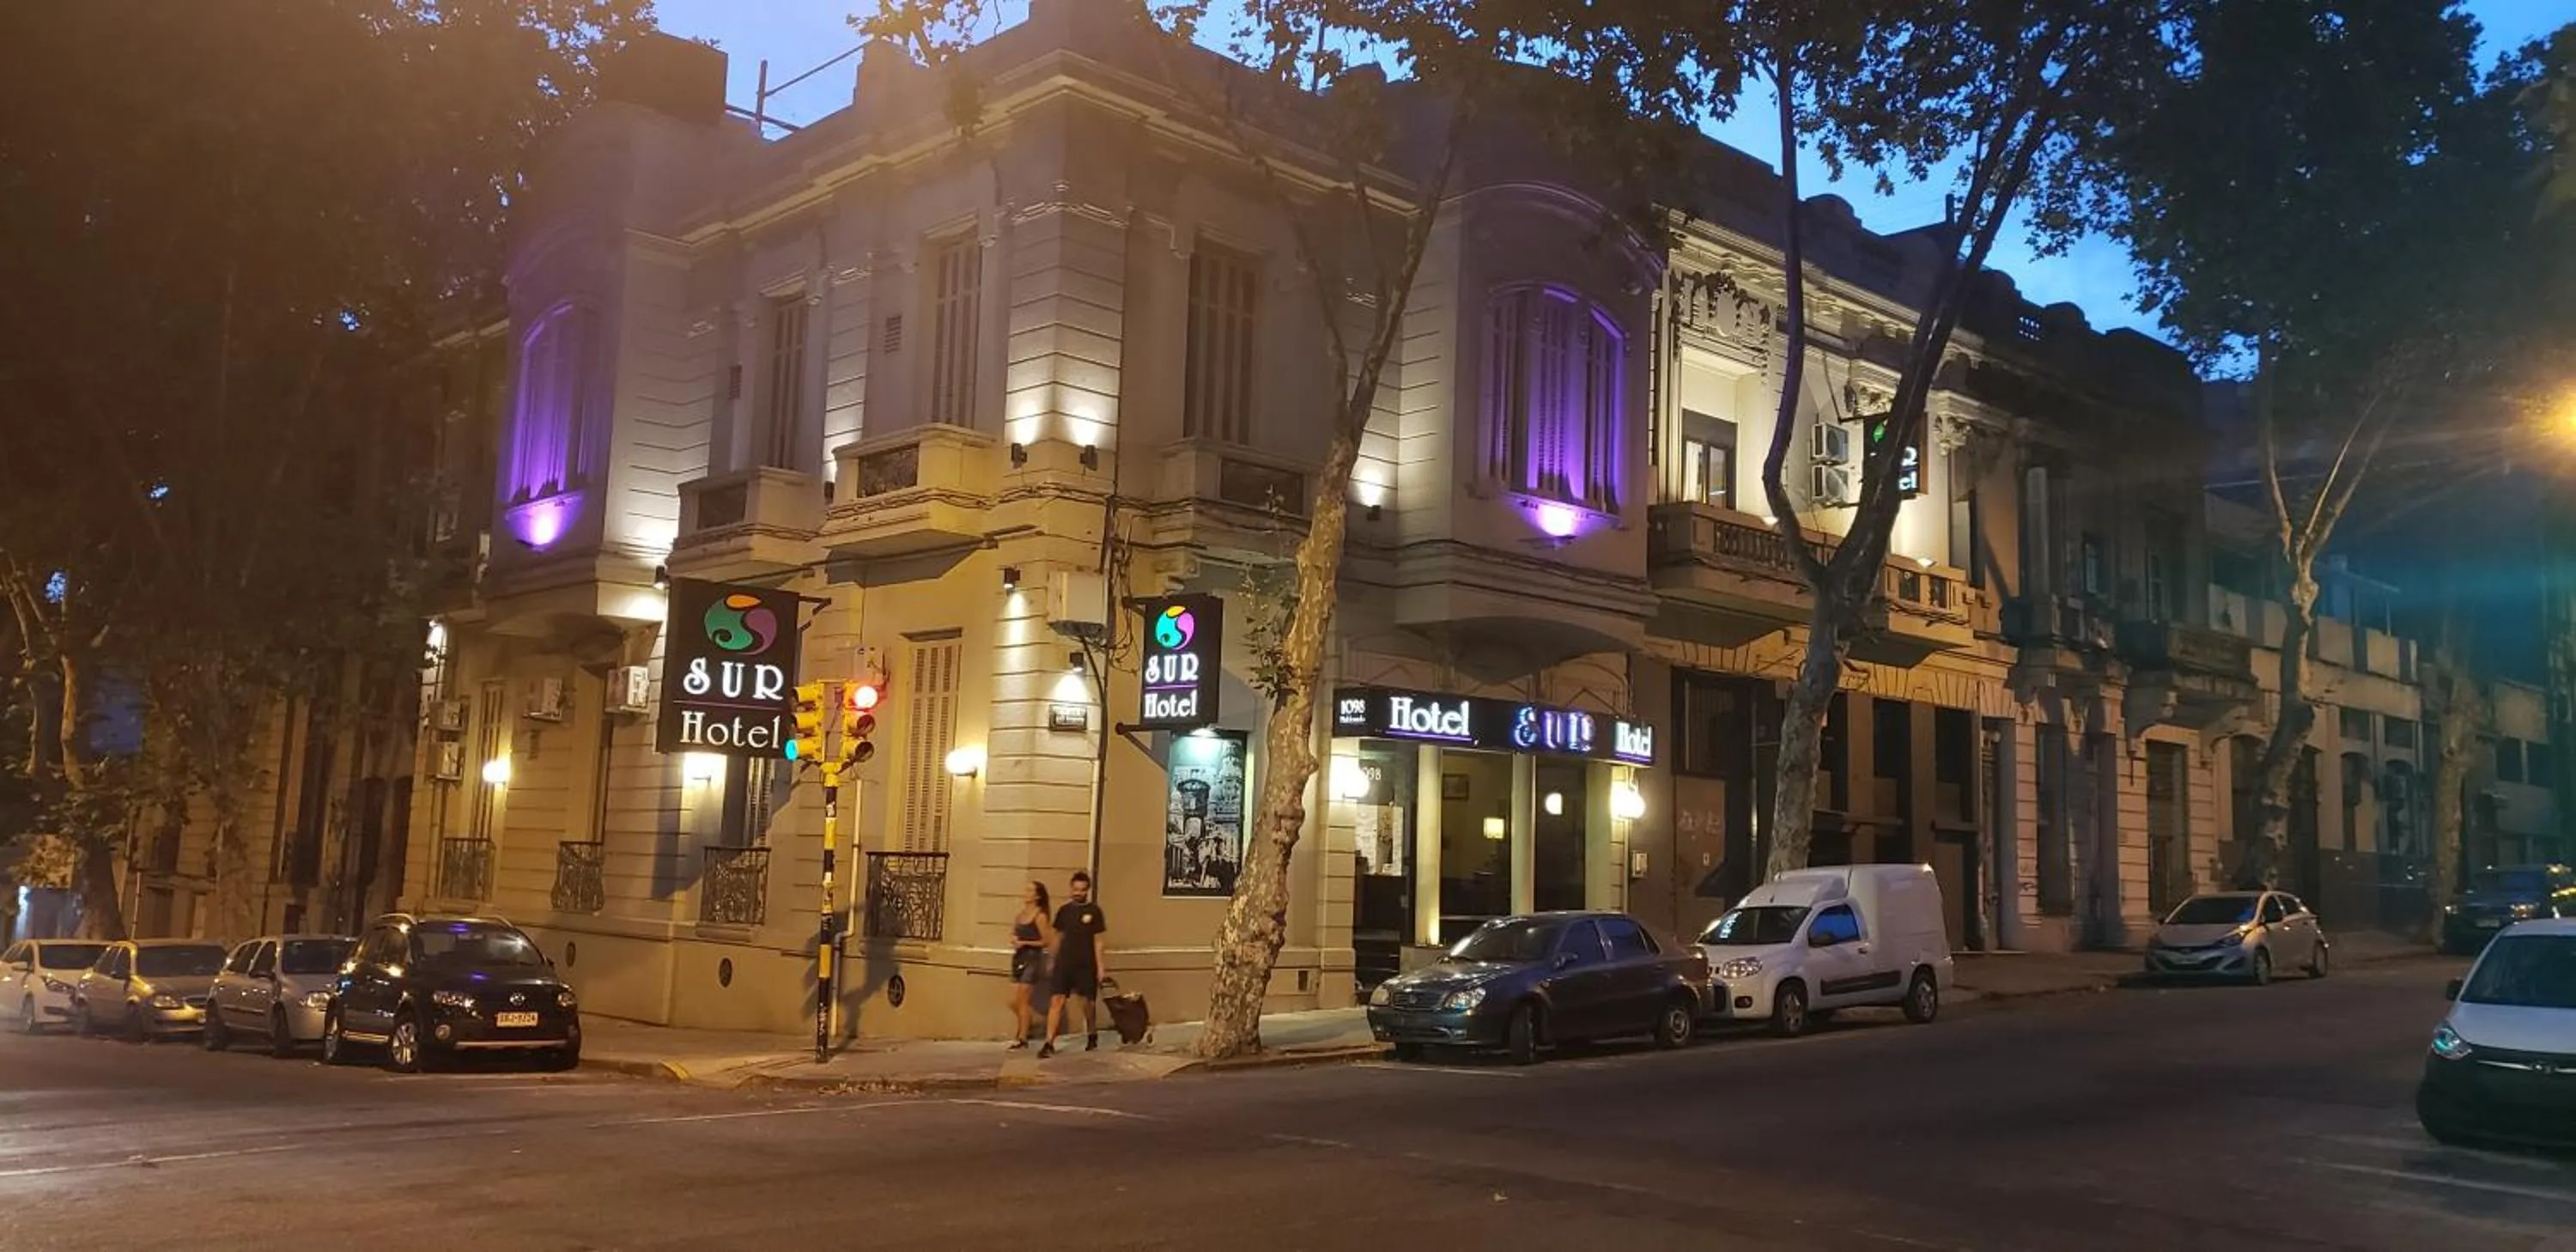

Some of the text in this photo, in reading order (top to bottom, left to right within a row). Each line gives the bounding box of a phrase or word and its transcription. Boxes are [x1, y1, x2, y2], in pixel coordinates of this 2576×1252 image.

[683, 657, 784, 701] SUR
[1145, 653, 1199, 684] SUR
[1144, 690, 1198, 718] Hotel
[1340, 699, 1365, 714] 1098
[1389, 696, 1470, 735] Hotel
[679, 711, 781, 749] Hotel
[1615, 721, 1652, 757] Hotel
